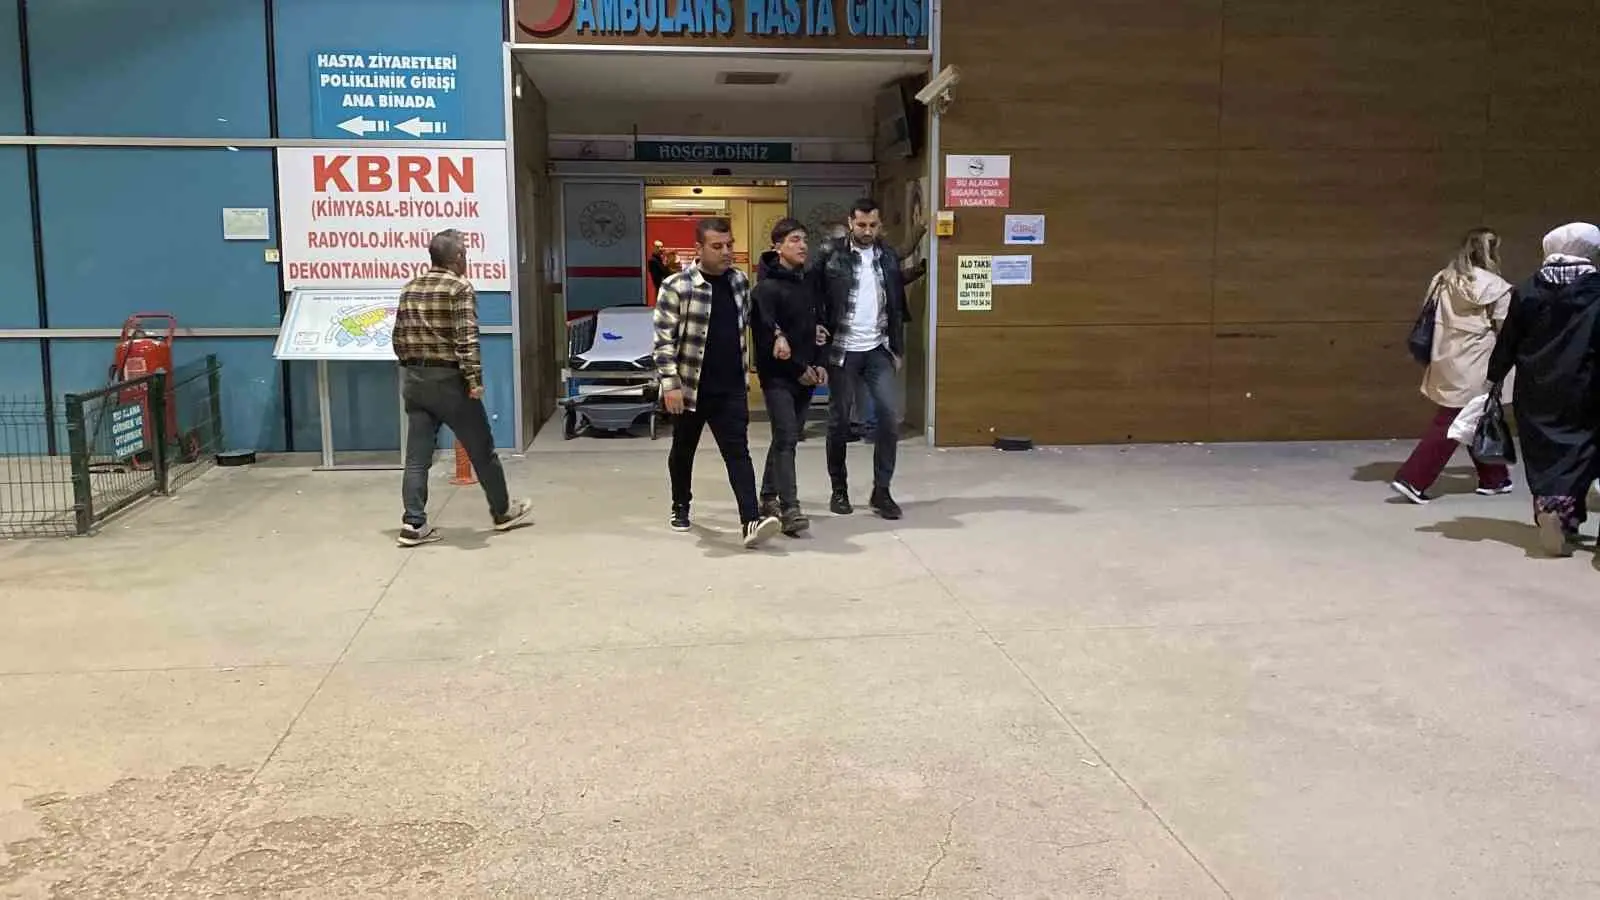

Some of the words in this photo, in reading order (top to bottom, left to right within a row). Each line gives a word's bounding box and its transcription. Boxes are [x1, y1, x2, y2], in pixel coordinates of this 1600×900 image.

[576, 0, 735, 35] AMBULANS
[744, 0, 837, 36] HASTA
[317, 54, 364, 67] HASTA
[368, 53, 457, 70] ZİYARETLERİ
[320, 71, 407, 88] POLİKLİNİK
[410, 72, 456, 93] GİRİŞİ
[342, 94, 375, 107] ANA
[379, 91, 436, 108] BİNADA
[313, 155, 475, 193] KBRN
[311, 196, 479, 220] (KİMYASAL-BİYOLOJİK
[308, 228, 485, 252] RADYOLOJİK-NÜER)
[290, 258, 430, 279] DEKONTAMİNASYO
[960, 260, 973, 268] ALO
